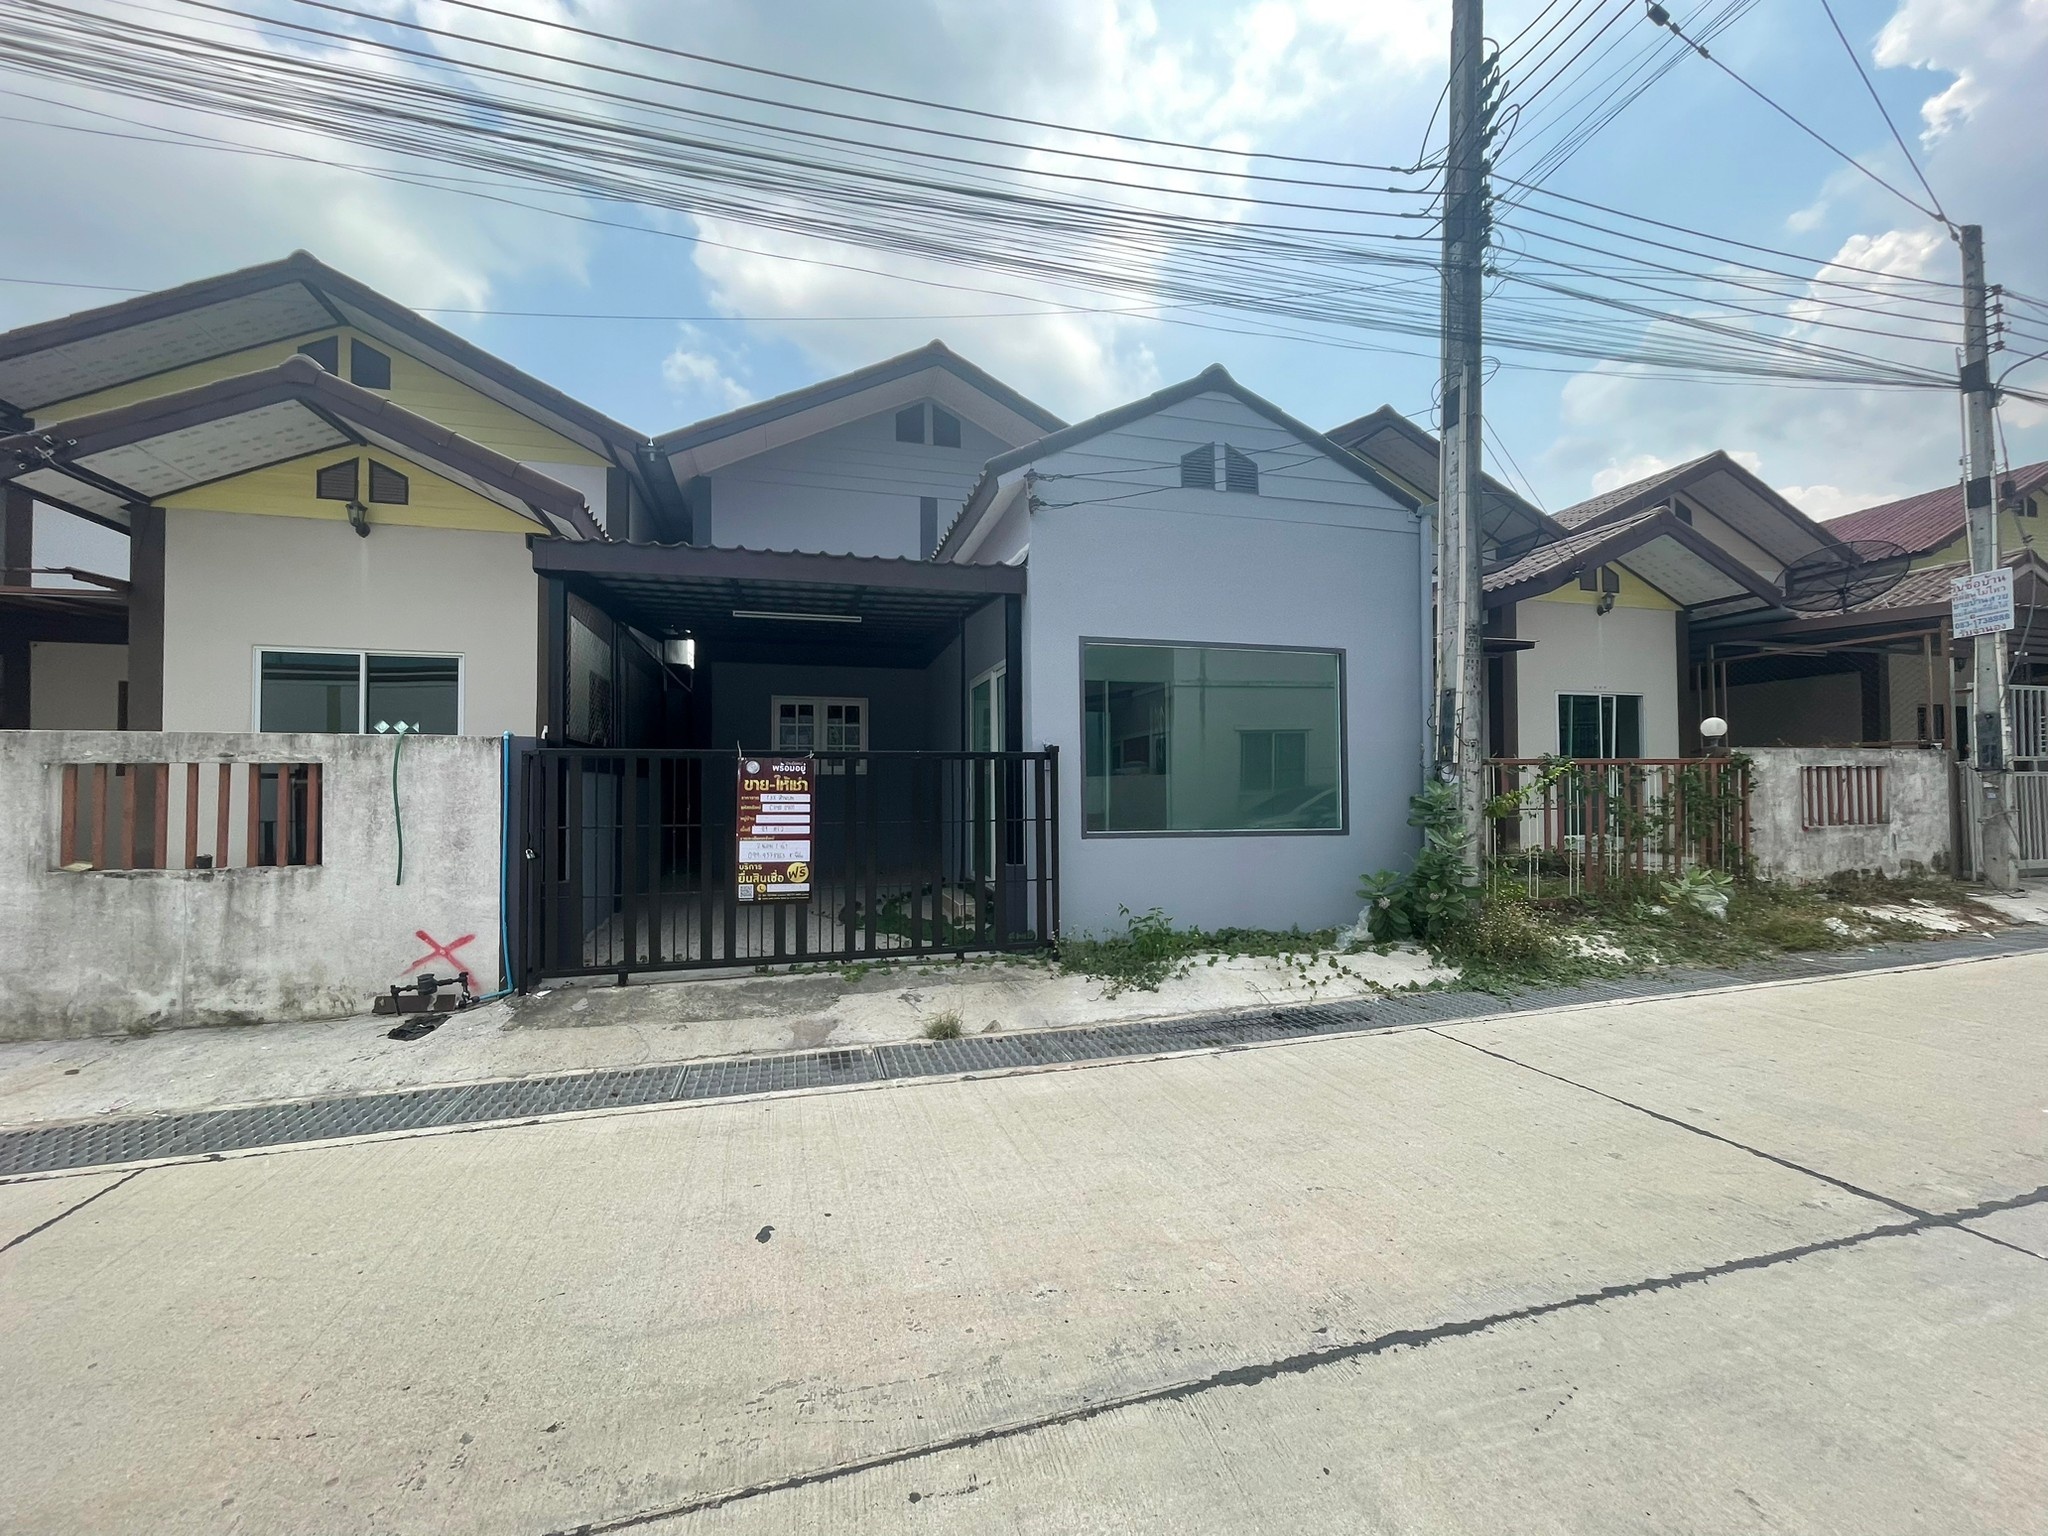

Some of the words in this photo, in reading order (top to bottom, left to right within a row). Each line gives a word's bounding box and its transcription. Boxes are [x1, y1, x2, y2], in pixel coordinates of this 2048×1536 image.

[772, 762, 806, 774] พร้อมอยู่
[744, 774, 808, 791] ขาย-ให้เช่า
[738, 869, 784, 883] ยื่นสินเชื่อ
[788, 864, 807, 879] ฟรี
